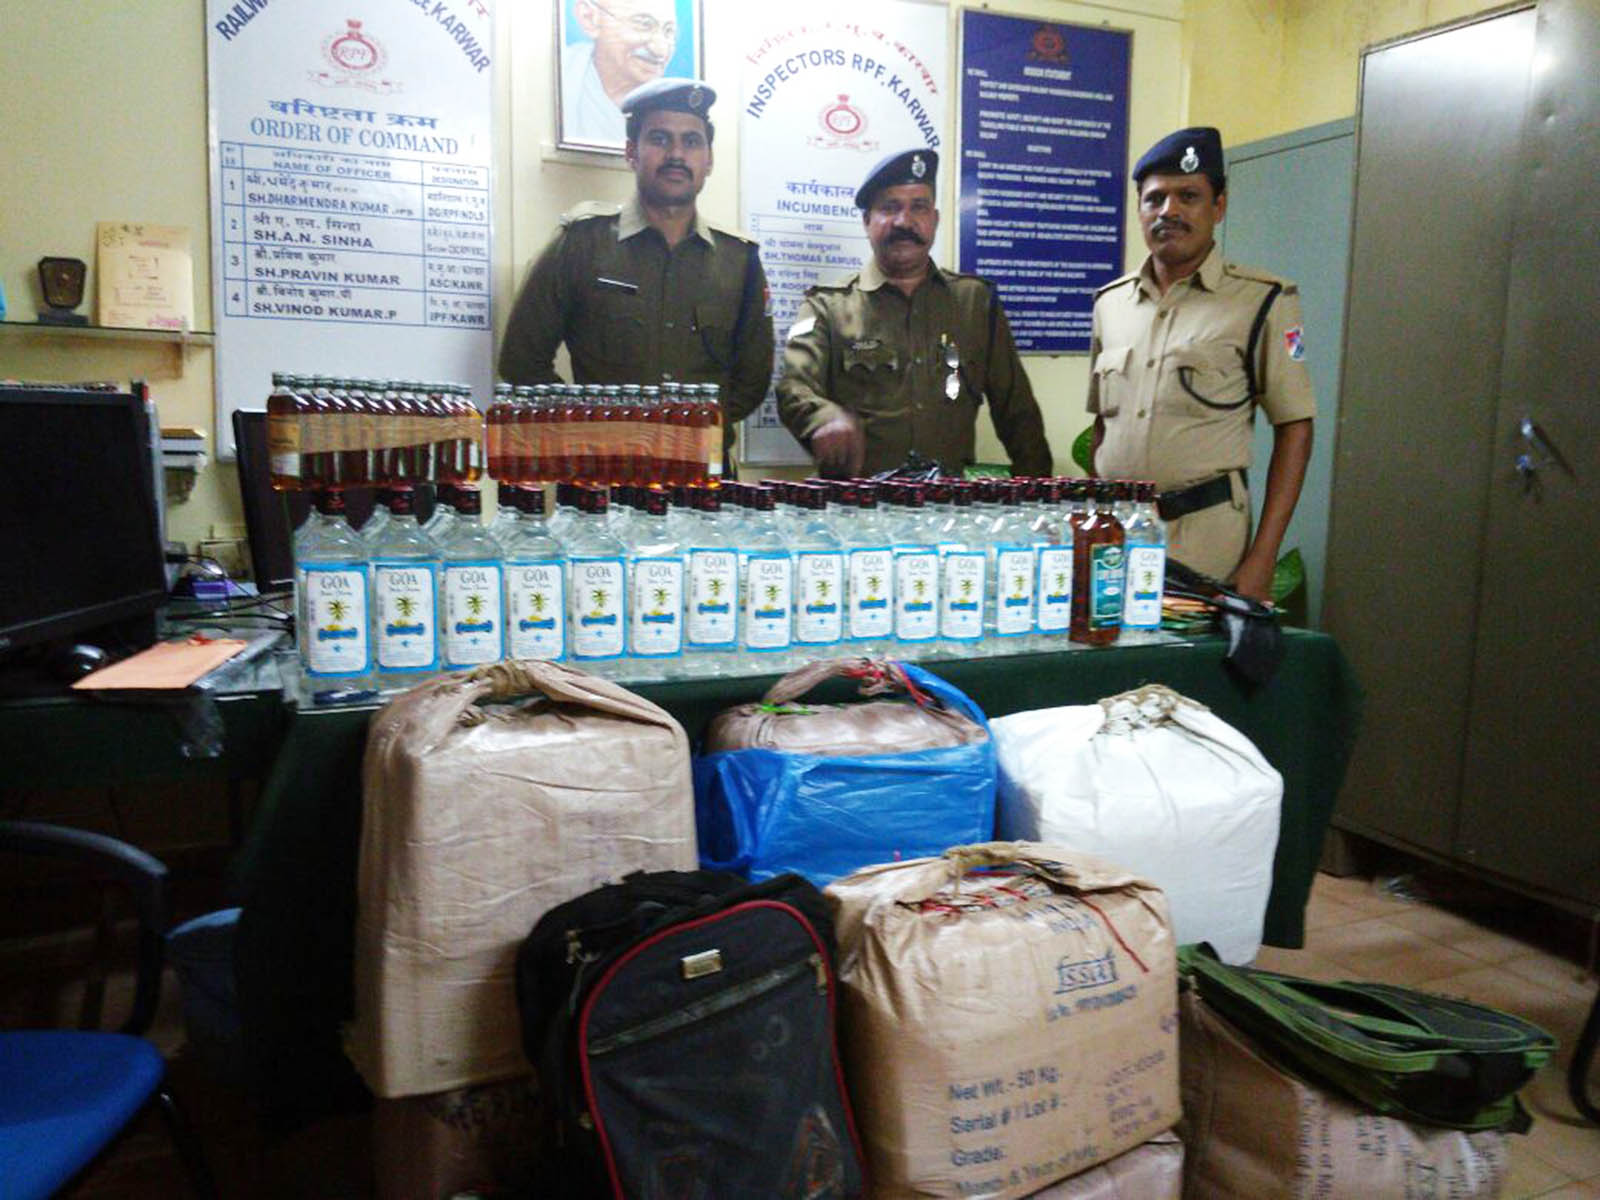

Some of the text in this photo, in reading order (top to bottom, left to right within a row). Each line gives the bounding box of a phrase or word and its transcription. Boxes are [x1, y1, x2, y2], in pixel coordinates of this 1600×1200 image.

[746, 49, 846, 119] INSPECTORS
[250, 117, 459, 155] ORDER OF COMMAND
[776, 200, 860, 218] INCUMBENC
[321, 233, 374, 248] SINHA
[231, 255, 240, 267] 3
[344, 272, 401, 286] KUMAR
[231, 291, 240, 303] 4
[390, 571, 419, 586] GOA
[460, 569, 488, 584] GOA
[523, 568, 550, 582] GOA
[586, 564, 613, 579] GOA
[320, 574, 351, 590] GOA
[950, 1113, 997, 1134] Serial
